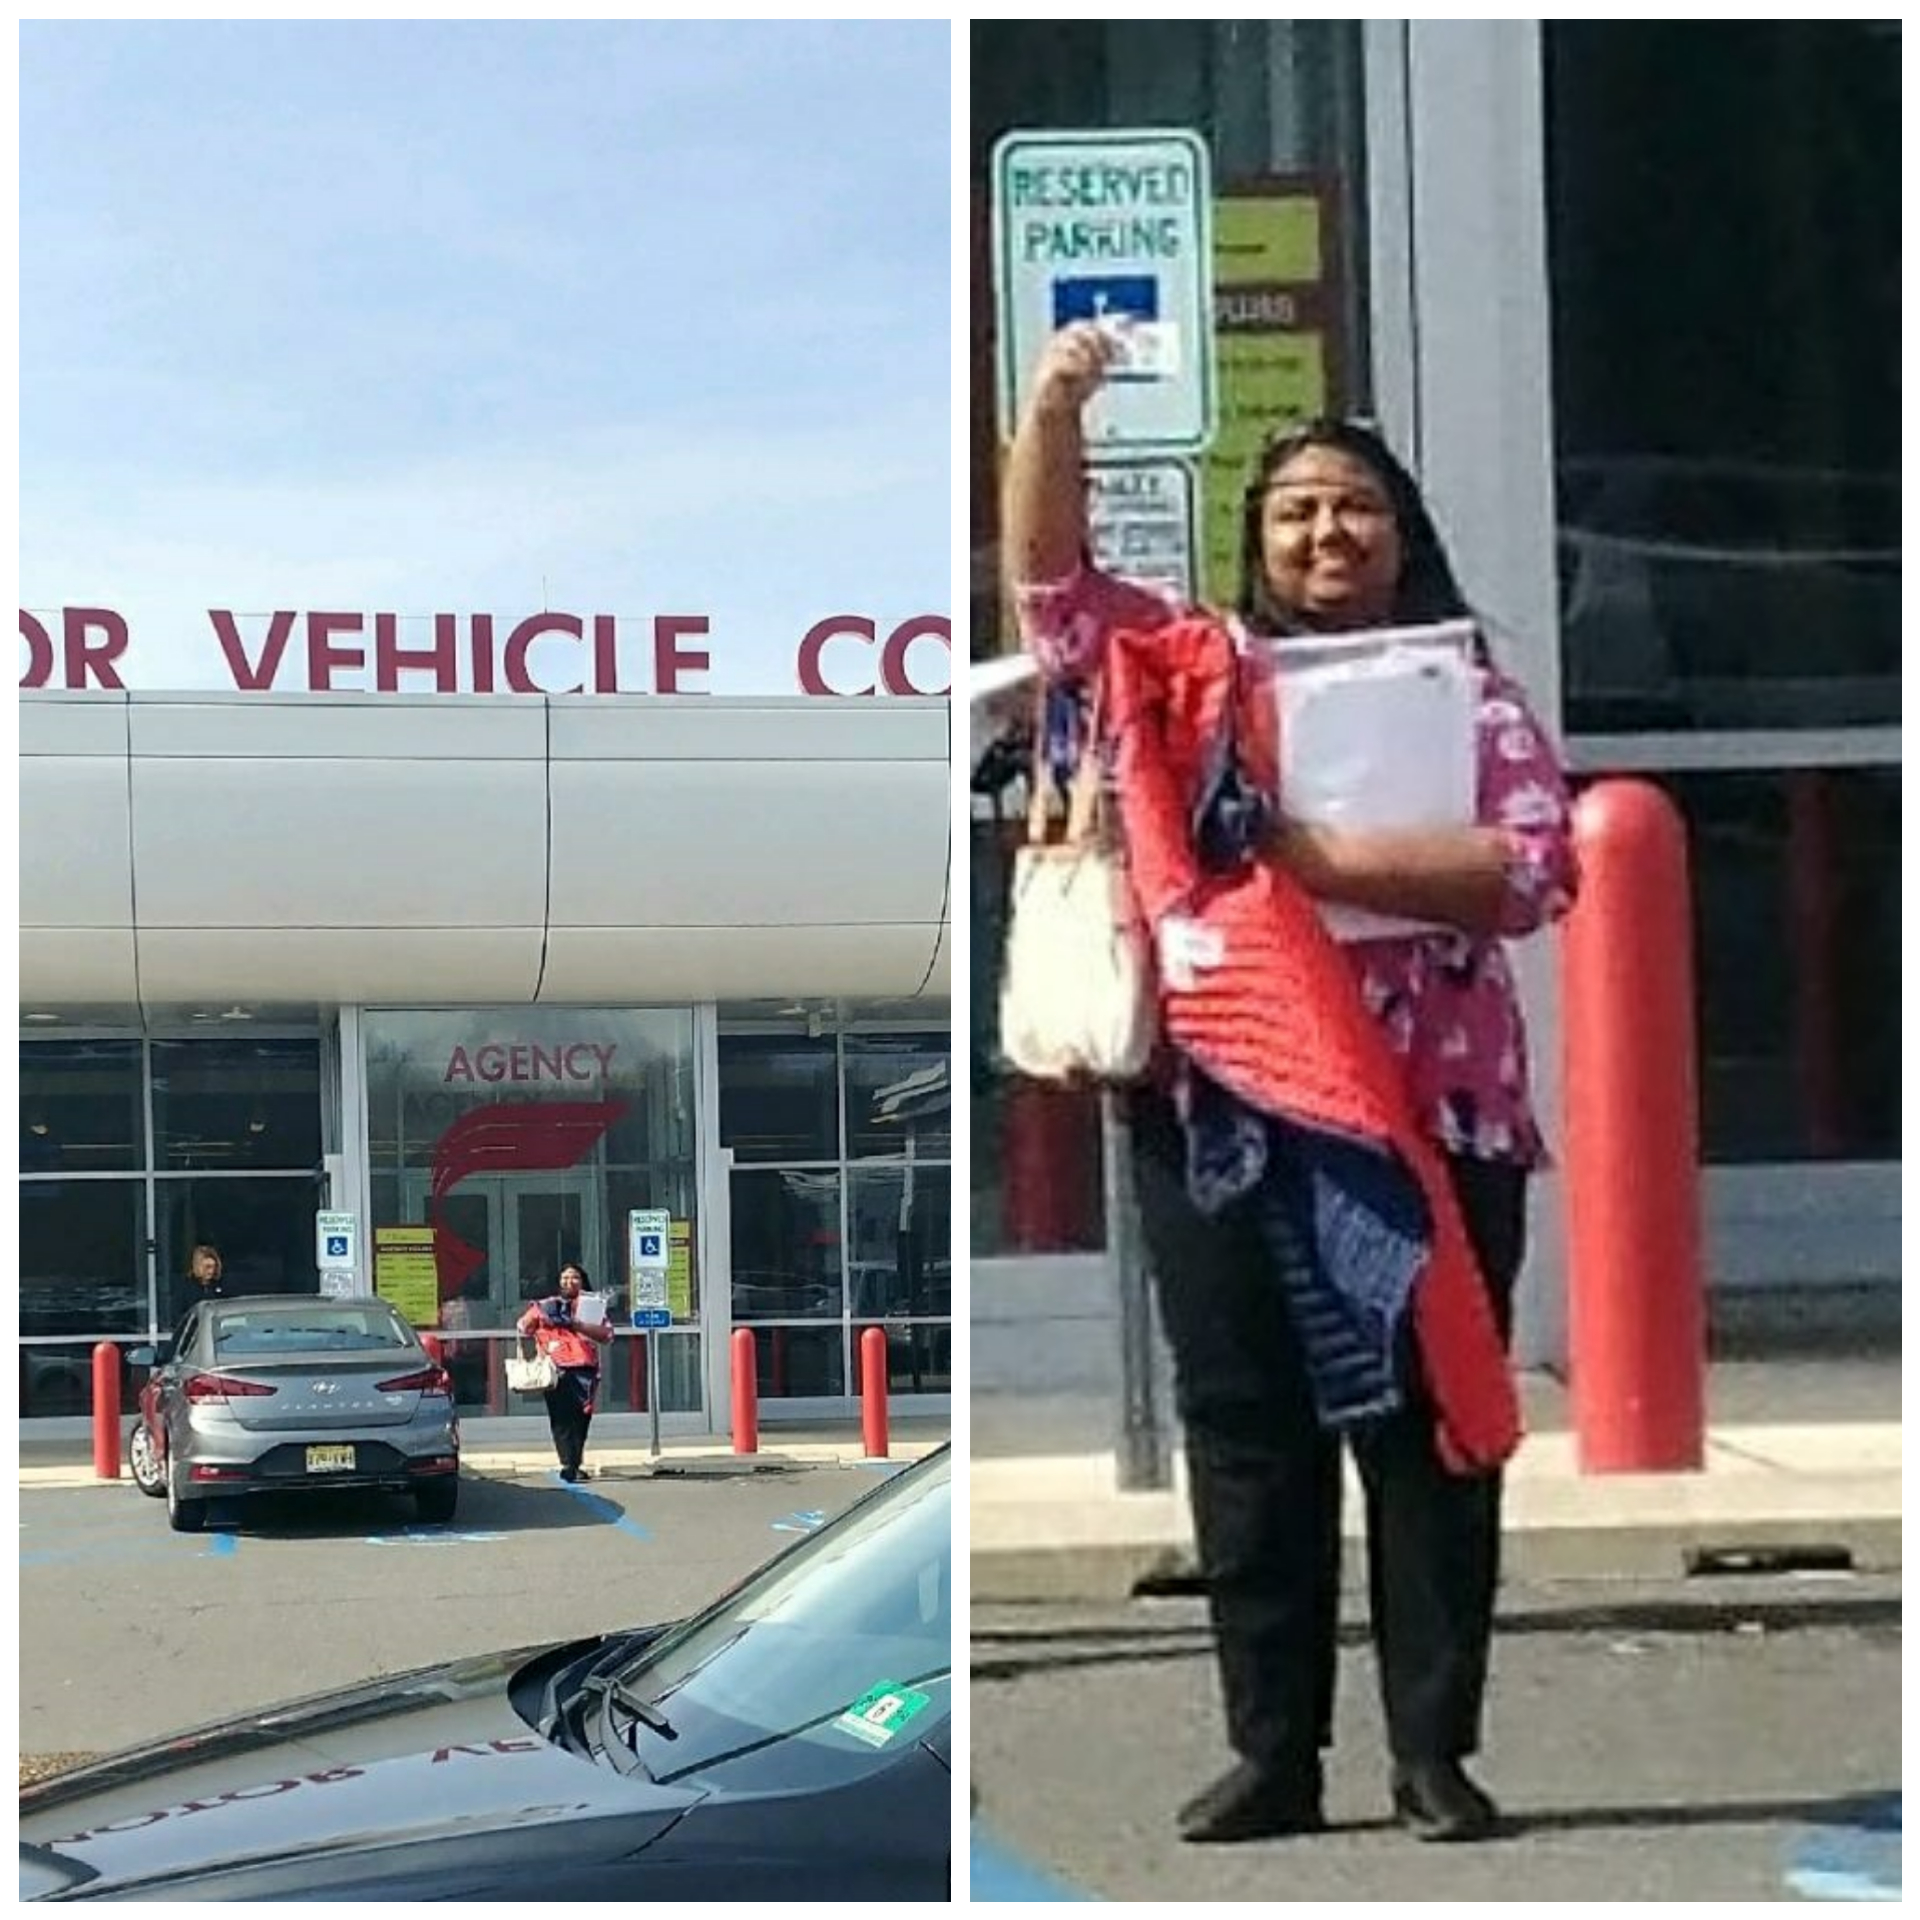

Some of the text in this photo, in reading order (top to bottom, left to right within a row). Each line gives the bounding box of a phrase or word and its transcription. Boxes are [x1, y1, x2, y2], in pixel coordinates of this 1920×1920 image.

[1013, 164, 1189, 206] RESERVED
[1025, 218, 1181, 260] PARKING
[207, 609, 710, 694] VEHICLE
[444, 1043, 617, 1082] AGENCY
